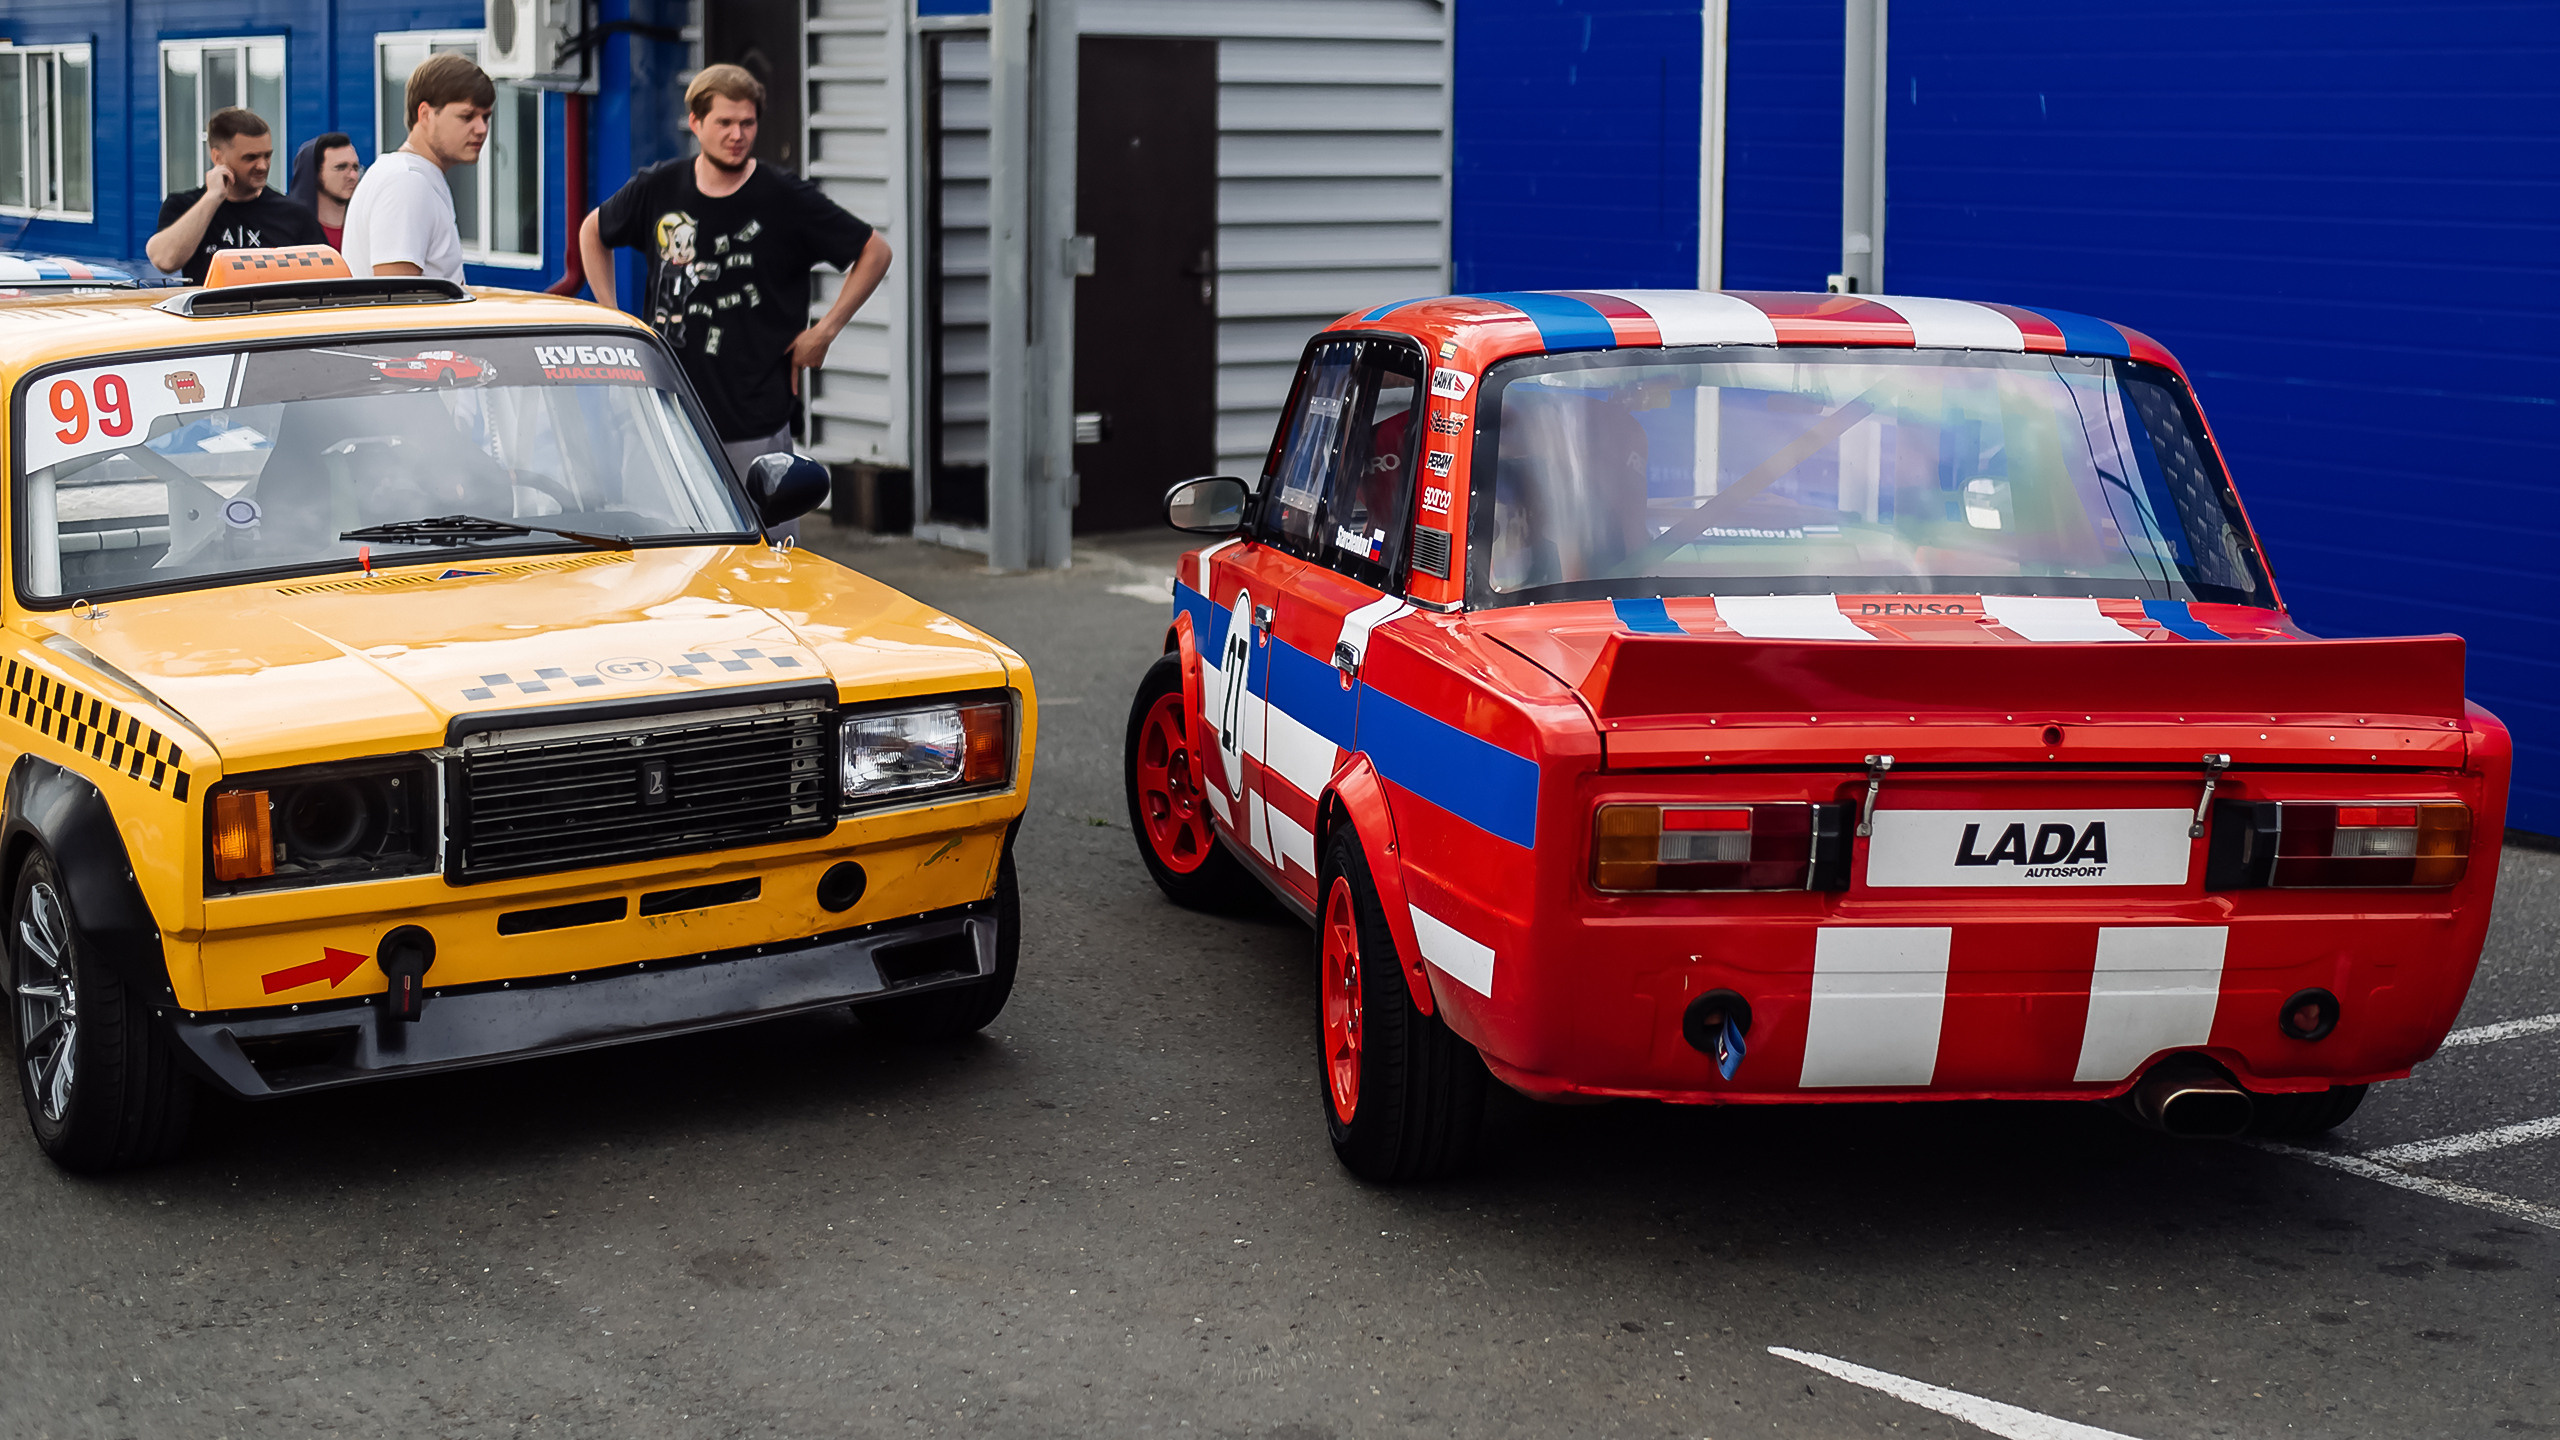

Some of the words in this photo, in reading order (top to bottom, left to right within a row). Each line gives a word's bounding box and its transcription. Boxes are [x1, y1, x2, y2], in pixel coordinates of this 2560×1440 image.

[534, 345, 641, 367] КУБОК
[543, 366, 647, 382] КЛАССИКИ
[1432, 370, 1455, 391] HAWK
[48, 373, 134, 445] 99
[1423, 486, 1452, 512] sparco
[1861, 603, 1965, 616] DENSO
[606, 661, 650, 674] GT
[1221, 632, 1249, 758] 27
[1954, 821, 2109, 866] LADA
[2024, 866, 2107, 878] AUTOSPORT
